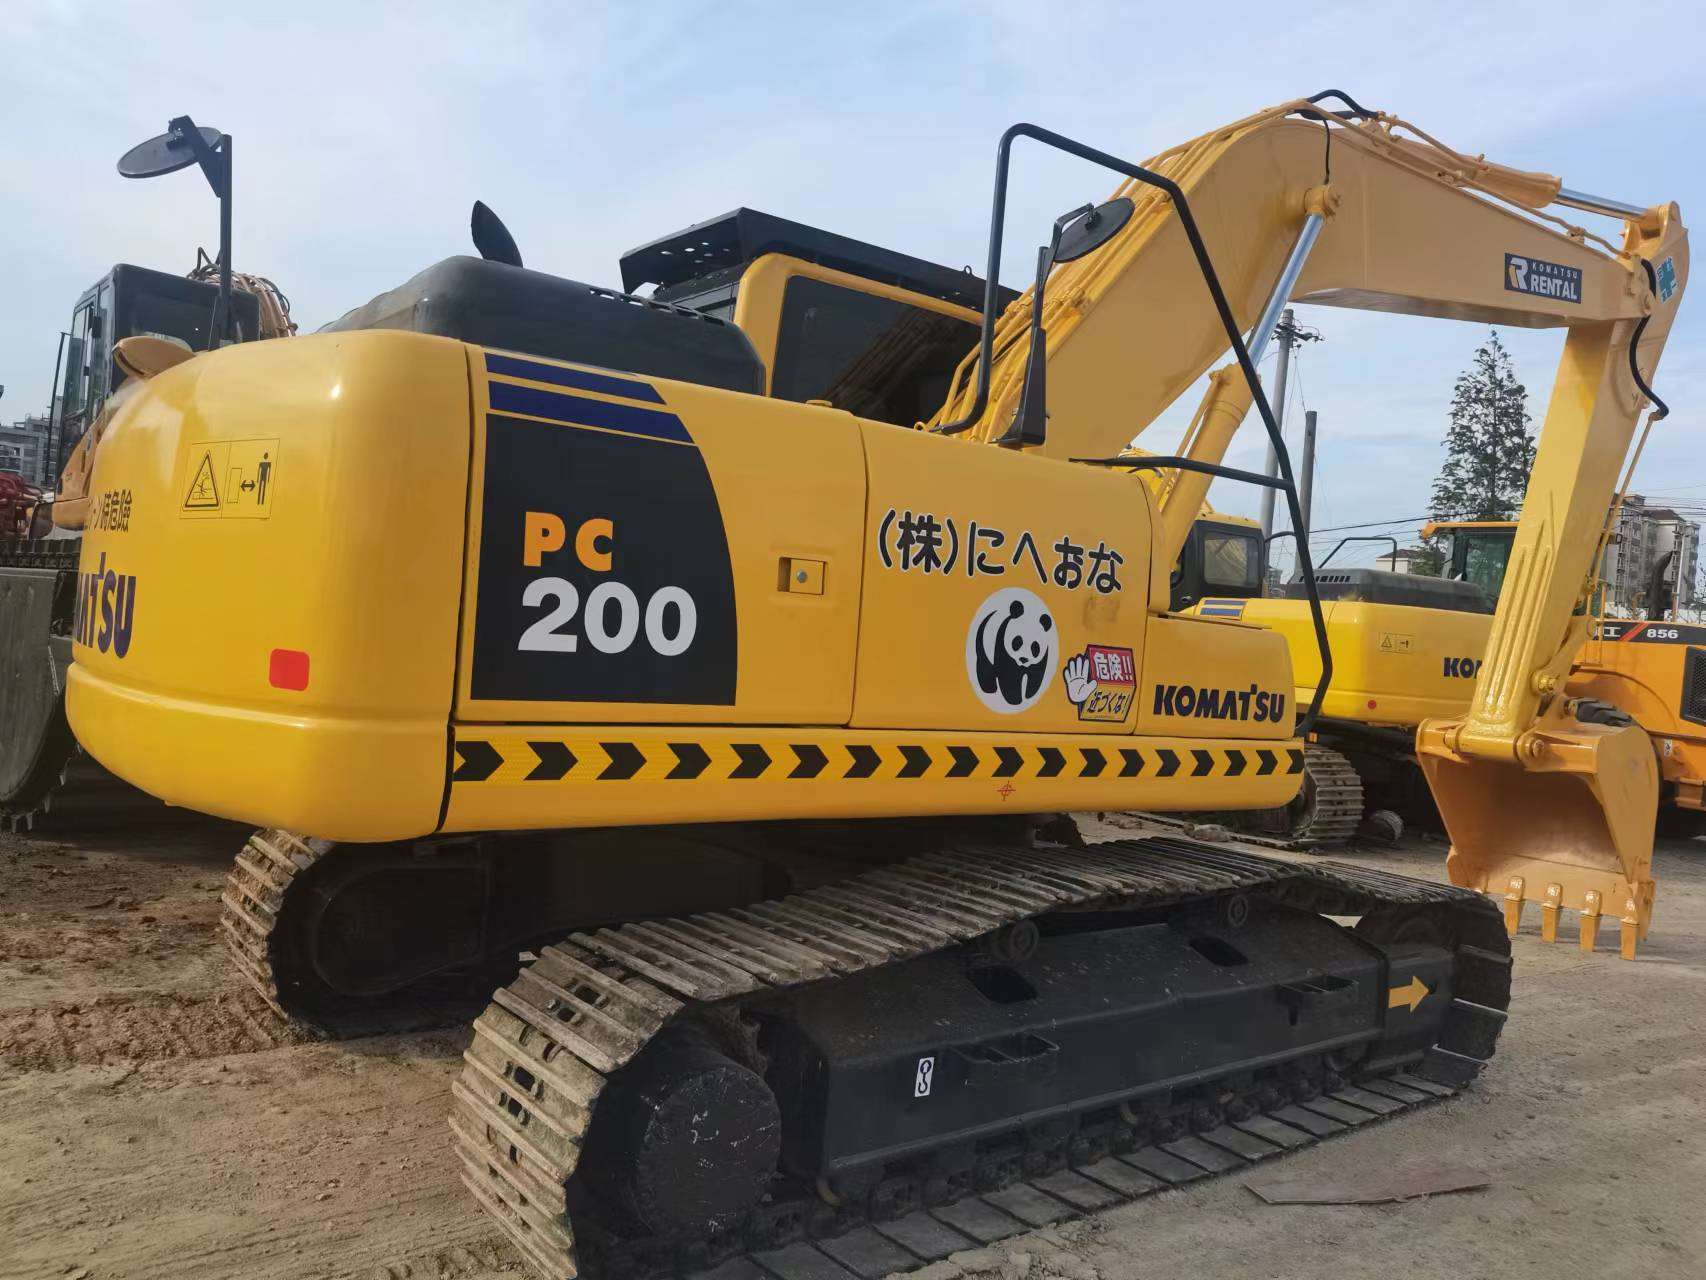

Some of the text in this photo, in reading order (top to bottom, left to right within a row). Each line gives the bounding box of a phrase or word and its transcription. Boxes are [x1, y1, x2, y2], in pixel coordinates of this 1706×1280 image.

[1532, 261, 1578, 279] KOMATSU
[1530, 274, 1578, 300] RENTAL
[523, 511, 613, 572] PC
[518, 576, 697, 657] 200
[1646, 628, 1679, 639] 856
[1152, 683, 1285, 723] KOMATSU
